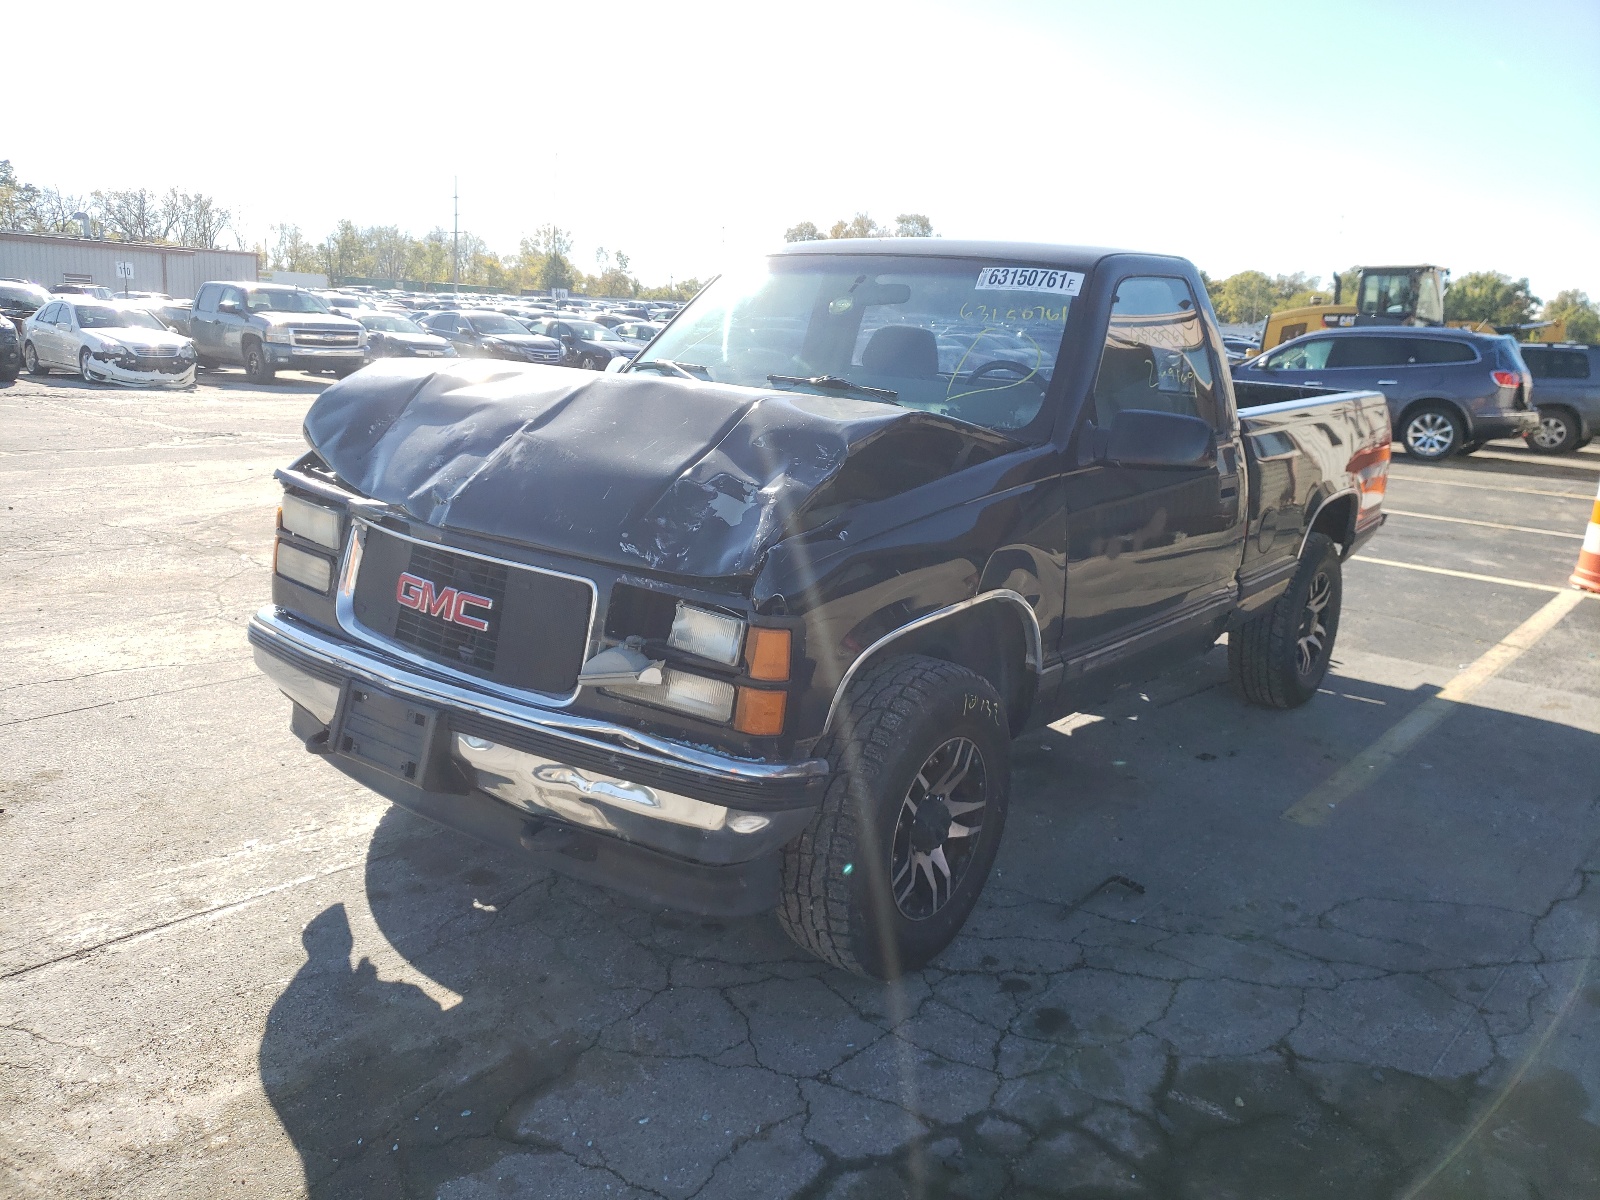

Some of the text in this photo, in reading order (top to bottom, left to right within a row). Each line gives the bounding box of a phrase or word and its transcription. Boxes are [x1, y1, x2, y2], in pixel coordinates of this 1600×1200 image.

[988, 268, 1068, 289] 63150761
[1066, 279, 1076, 288] F
[960, 302, 1069, 325] 63150761
[396, 571, 493, 632] GMC
